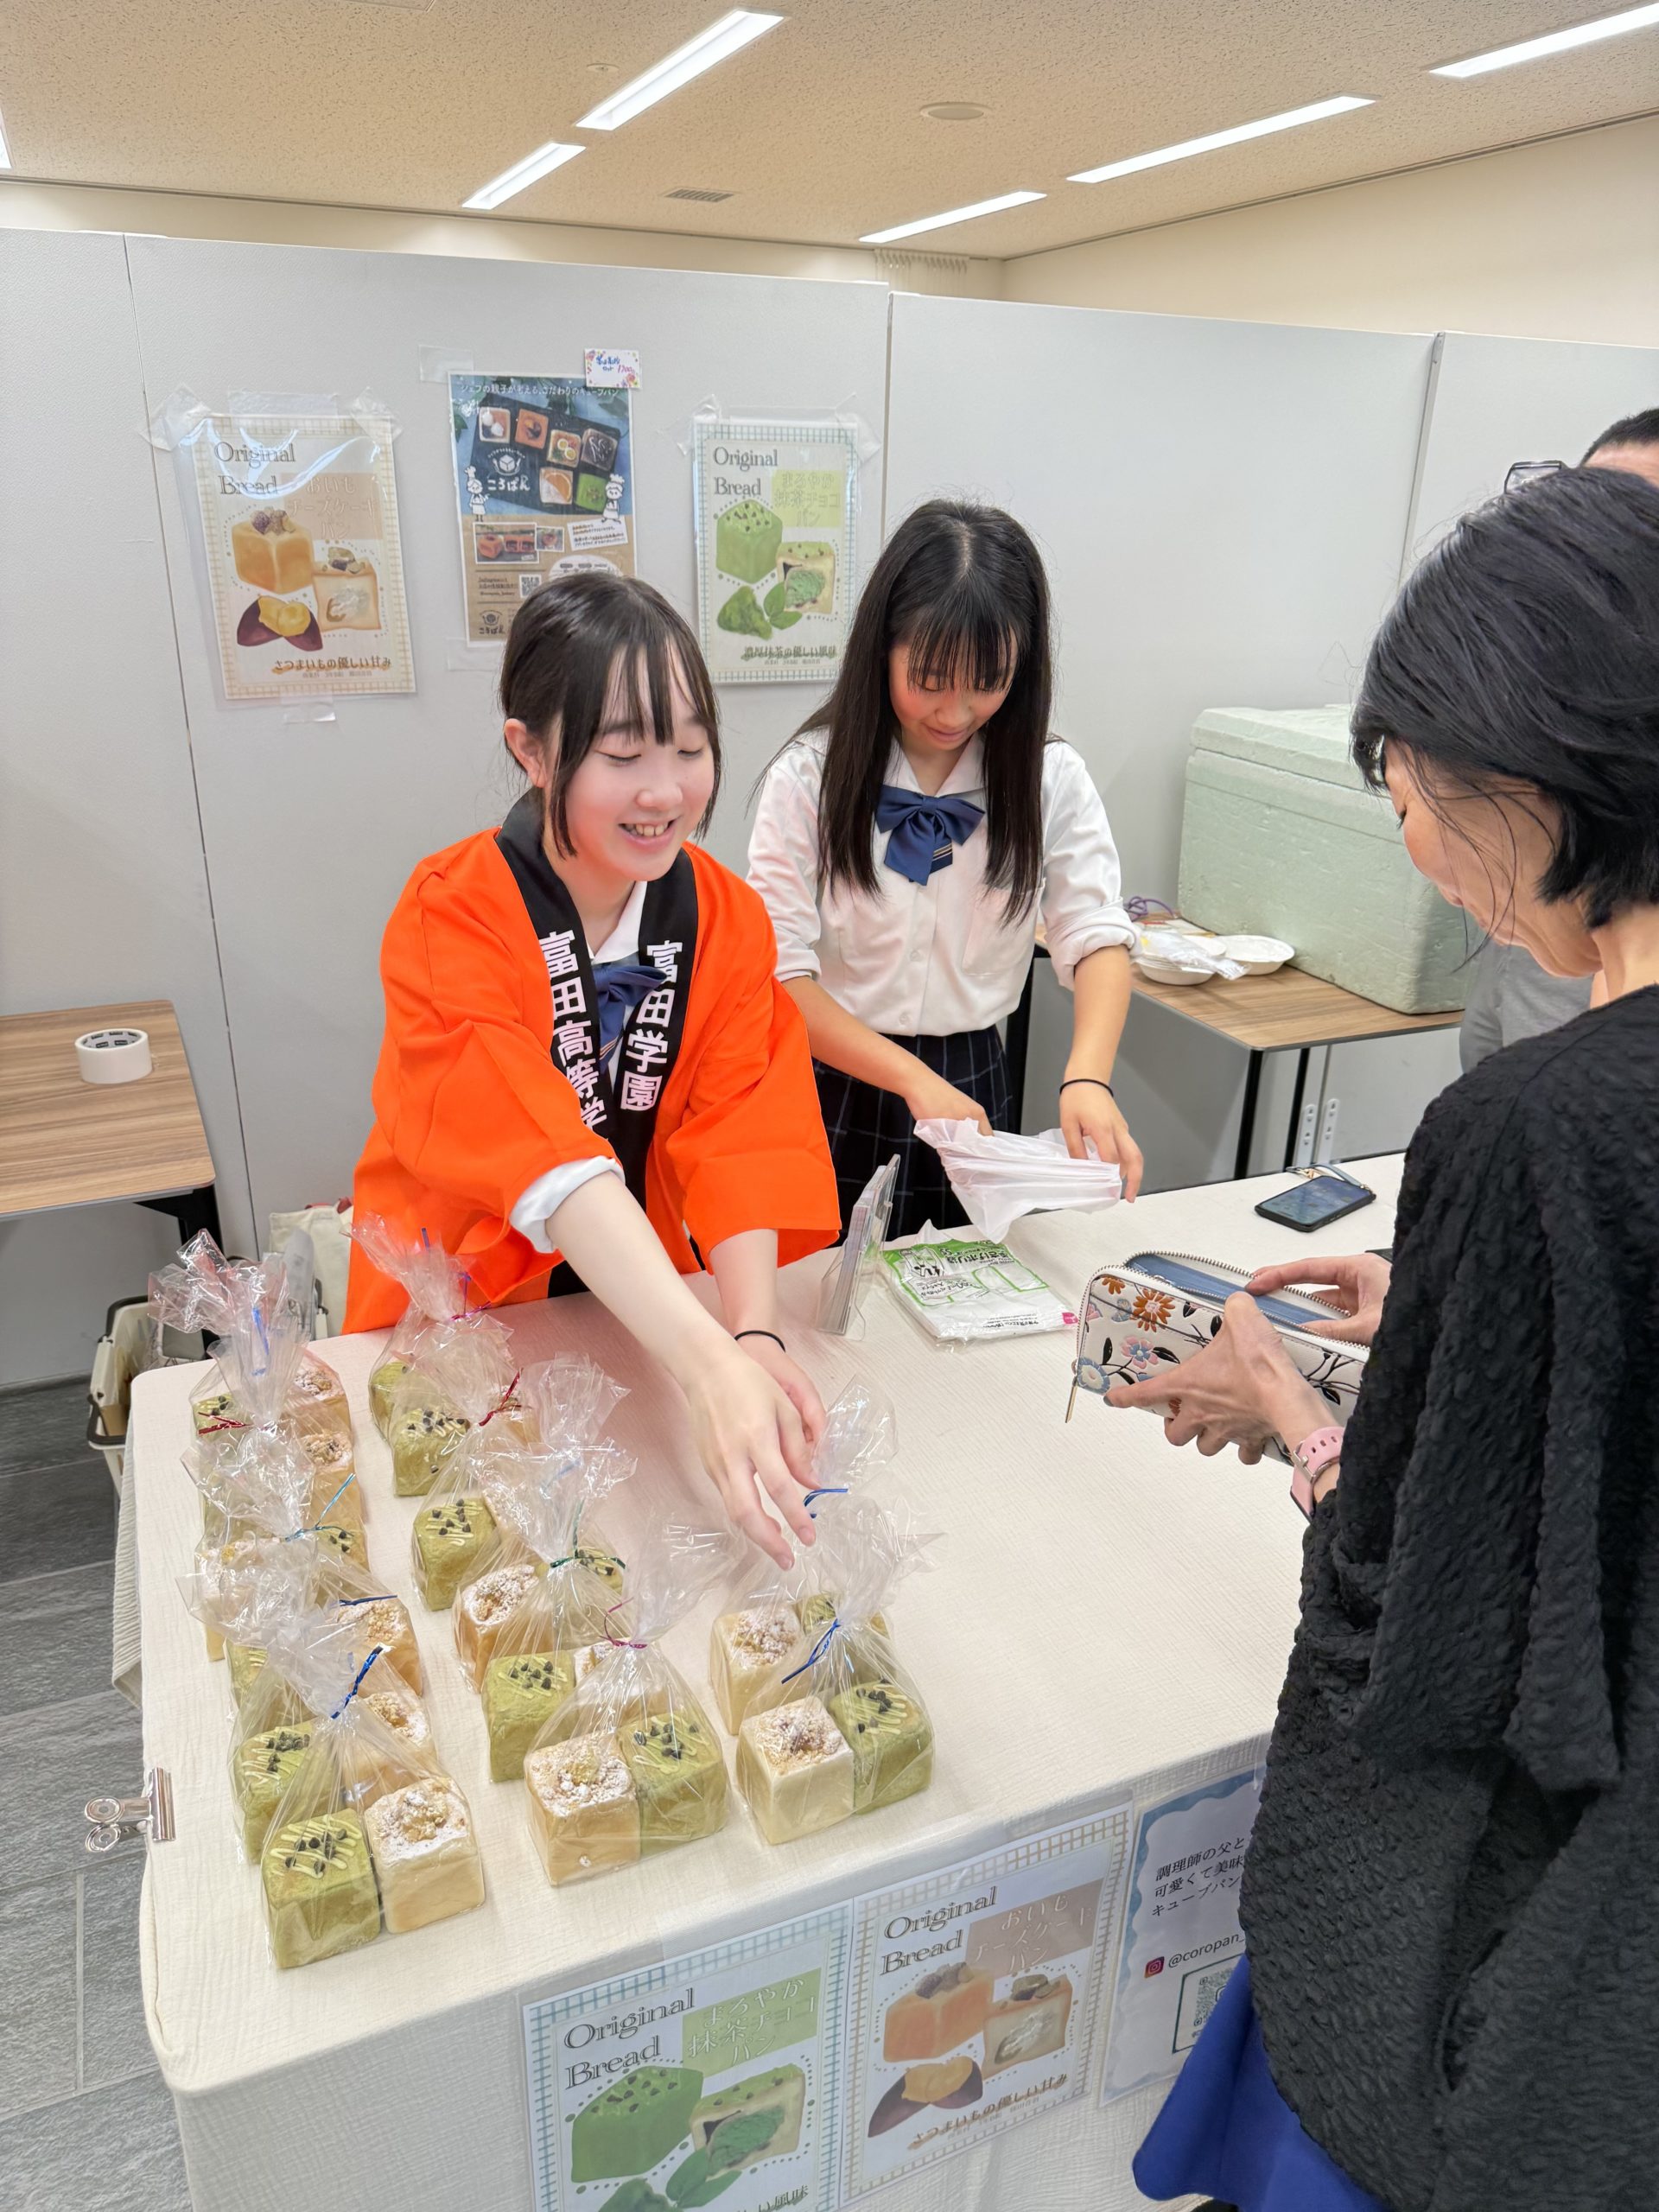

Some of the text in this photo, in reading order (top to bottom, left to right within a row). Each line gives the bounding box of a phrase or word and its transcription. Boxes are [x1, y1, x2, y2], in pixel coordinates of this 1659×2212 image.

[216, 441, 296, 468] Original
[713, 447, 778, 471] Original
[220, 475, 279, 496] Bread
[714, 477, 761, 497] Bread
[275, 655, 391, 671] さつまいもの優しい甘み
[1155, 1837, 1244, 1882] 調理師の父と
[1155, 1854, 1243, 1897] 可愛くて美味
[884, 1885, 997, 1941] Original
[880, 1929, 963, 1976] Bread
[563, 1986, 695, 2050] Original
[704, 1979, 804, 2028] まろやか
[564, 2035, 661, 2090] Bread
[732, 2035, 776, 2066] パン
[912, 2073, 1067, 2145] さつまいもの優しい甘み
